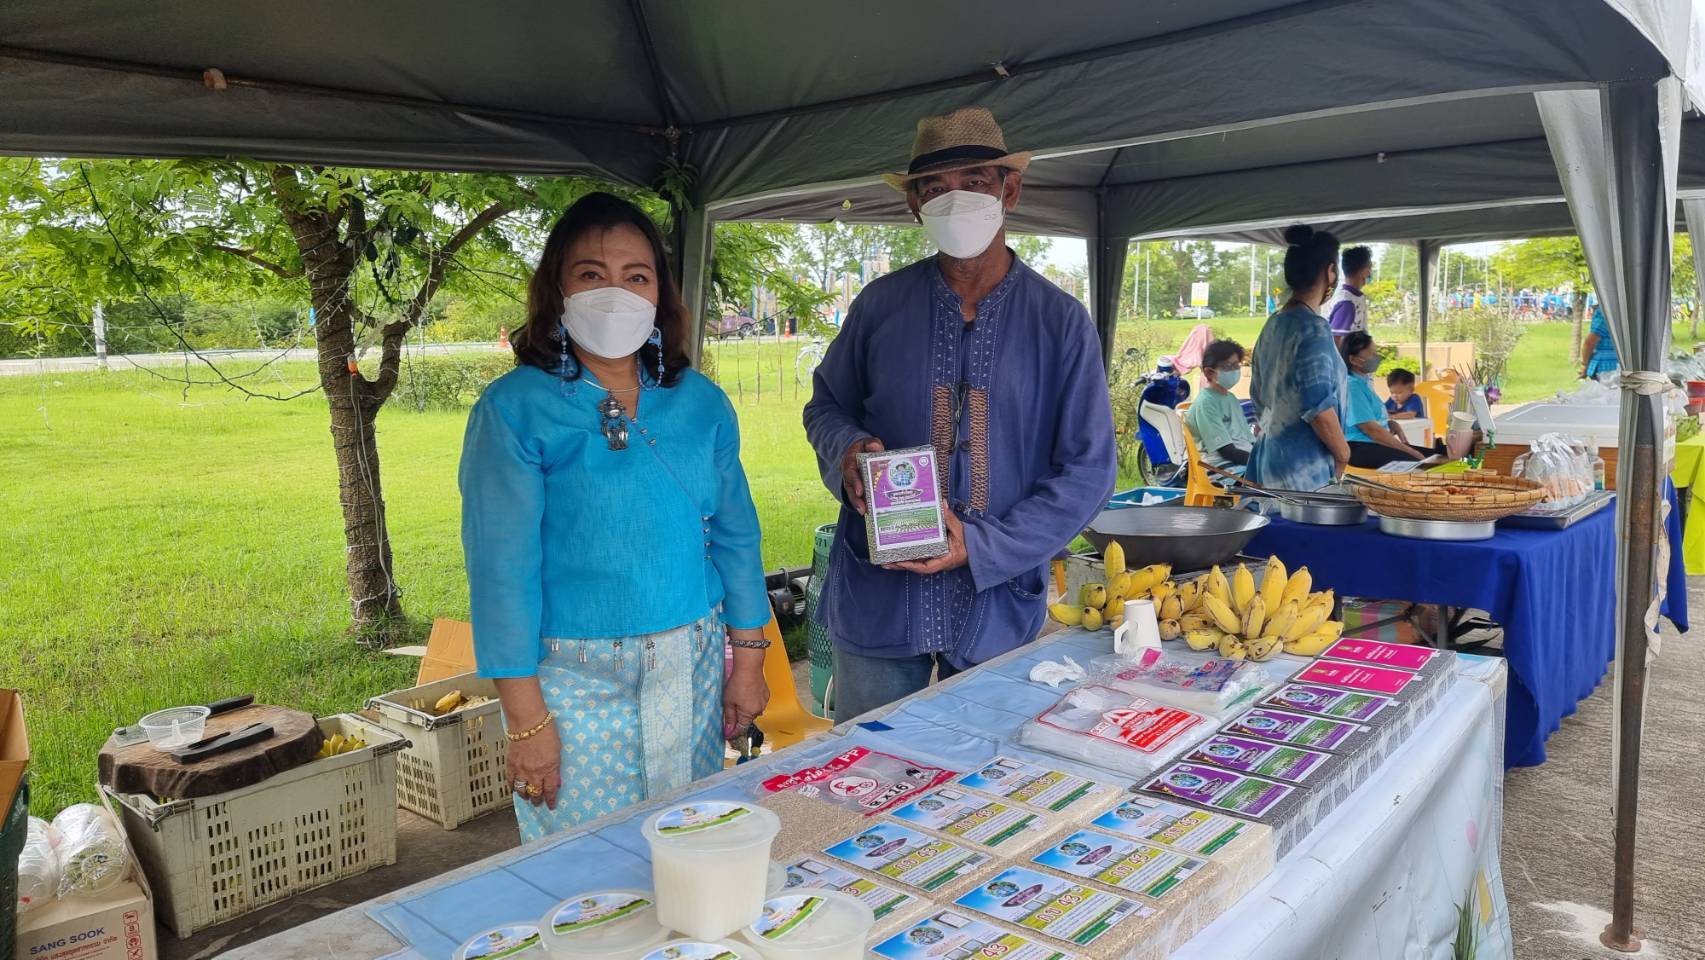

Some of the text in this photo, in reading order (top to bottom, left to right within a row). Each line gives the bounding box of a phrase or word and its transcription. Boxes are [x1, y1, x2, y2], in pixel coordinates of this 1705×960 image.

[838, 748, 859, 762] PP
[915, 846, 939, 858] 43
[1127, 852, 1150, 864] 43
[1057, 893, 1082, 908] 43
[30, 938, 66, 955] SANG
[69, 927, 105, 944] SOOK
[981, 942, 1009, 959] 43
